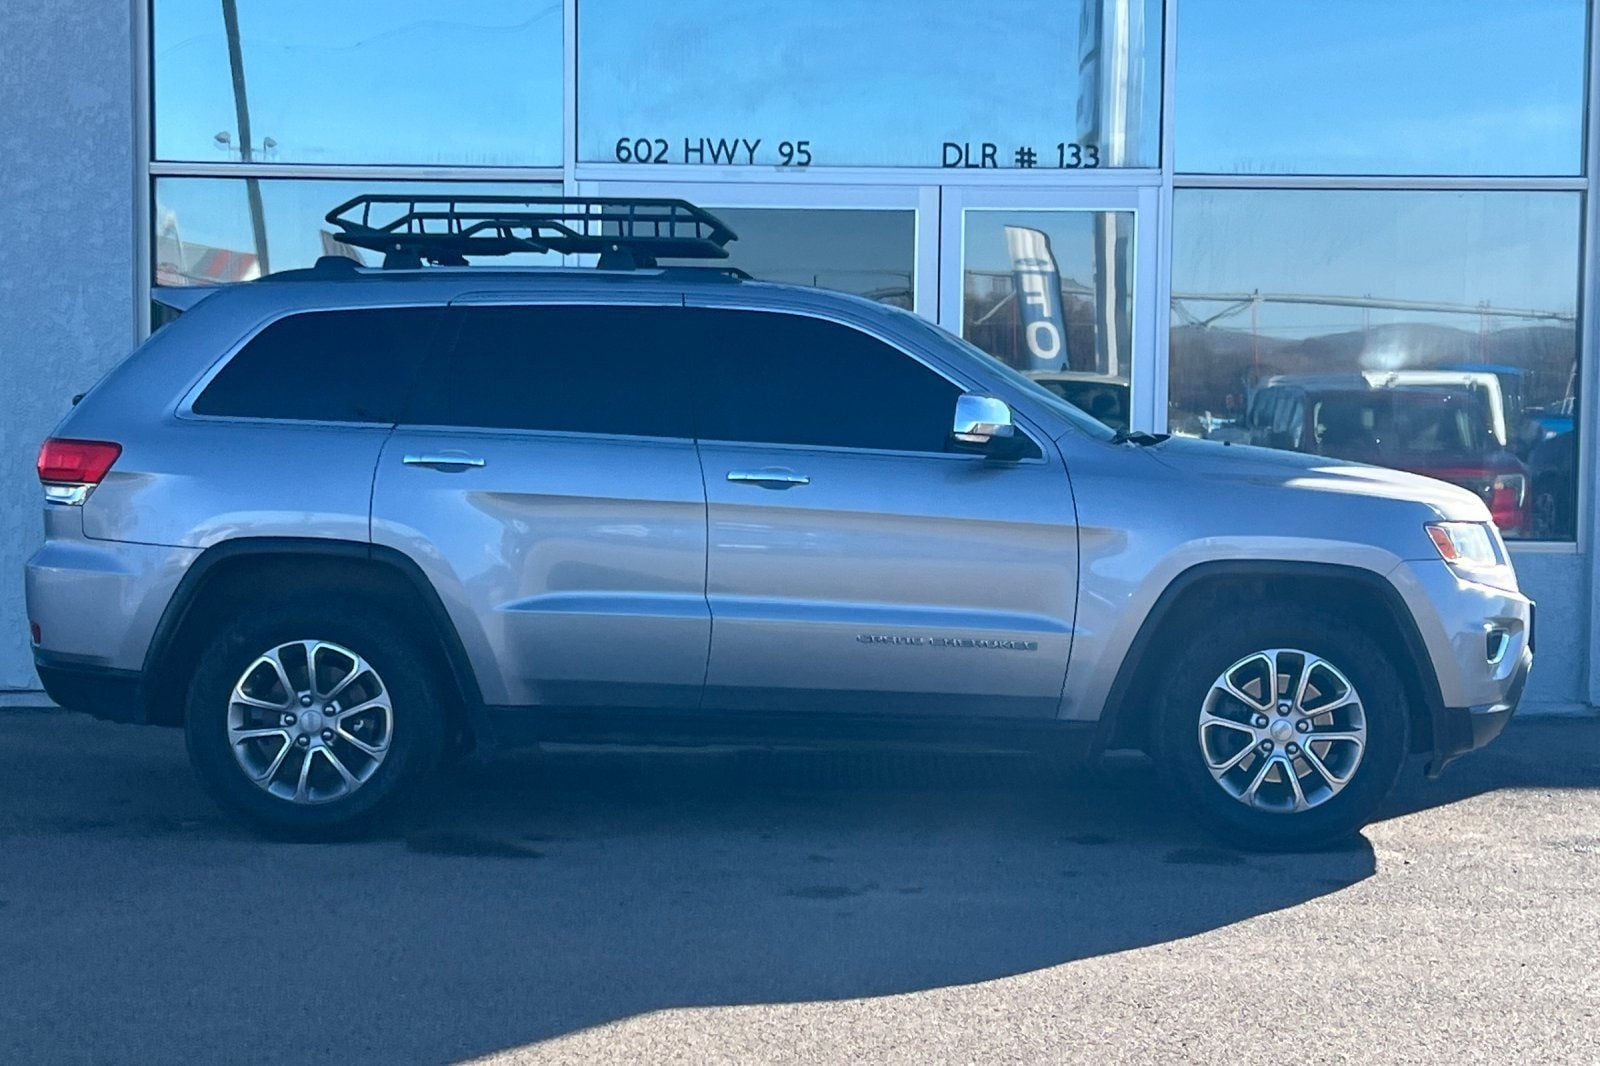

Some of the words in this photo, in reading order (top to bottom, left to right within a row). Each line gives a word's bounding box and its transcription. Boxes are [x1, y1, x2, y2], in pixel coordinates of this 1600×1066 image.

[615, 137, 669, 164] 602
[684, 137, 761, 165] HWY
[778, 141, 812, 167] 95
[943, 142, 998, 168] DLR
[1015, 146, 1037, 168] #
[1057, 142, 1099, 168] 133
